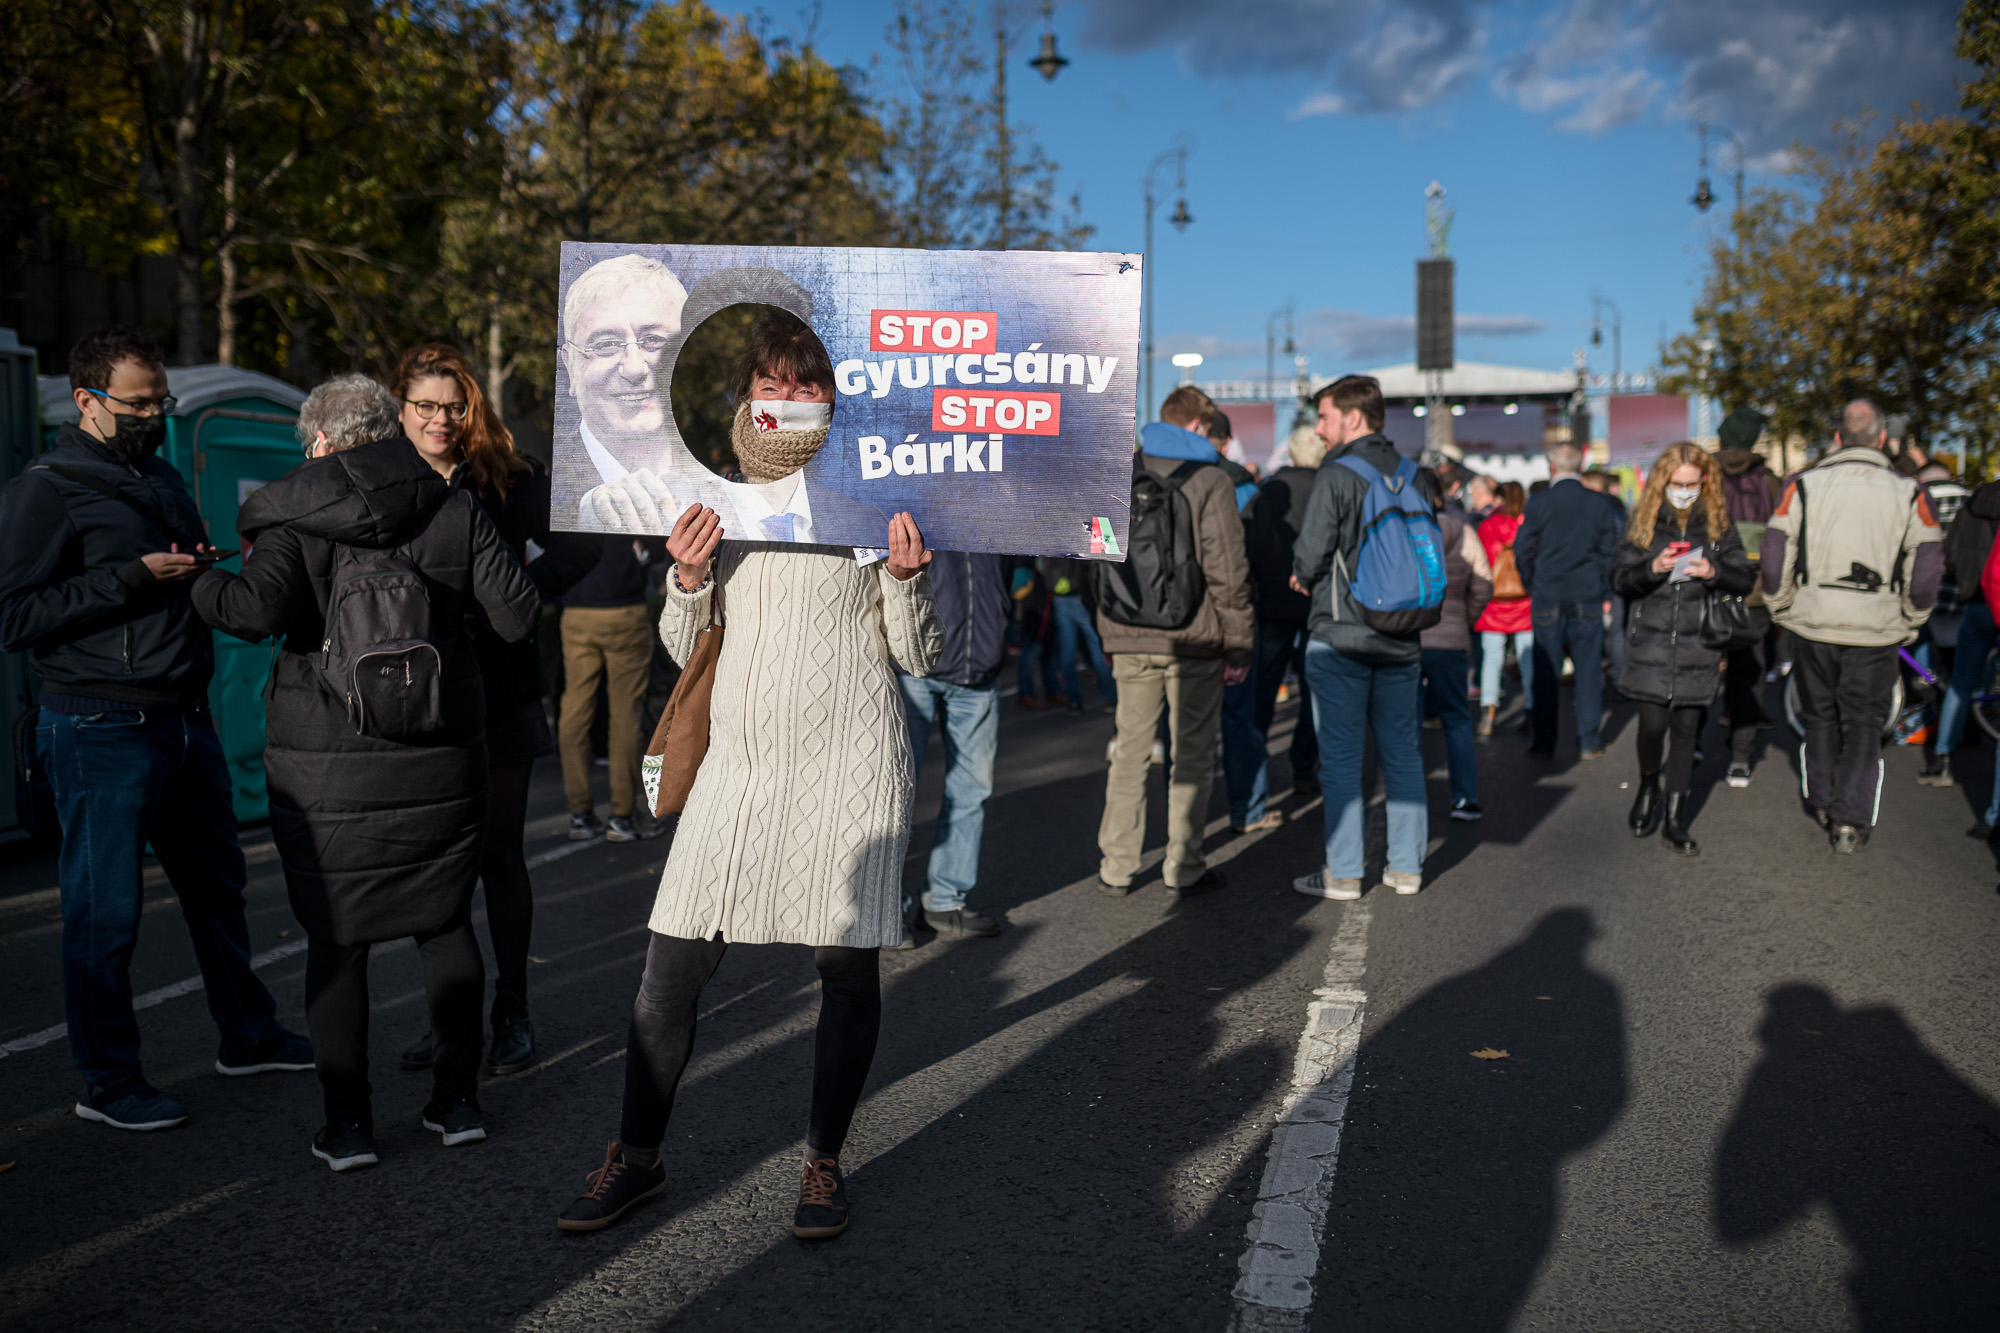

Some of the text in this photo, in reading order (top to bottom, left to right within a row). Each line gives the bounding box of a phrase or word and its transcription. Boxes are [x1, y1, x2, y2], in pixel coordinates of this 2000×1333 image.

[879, 315, 988, 348] STOP
[835, 343, 1119, 399] Gyurcsány
[941, 396, 1052, 429] STOP
[857, 433, 1003, 480] Bárki
